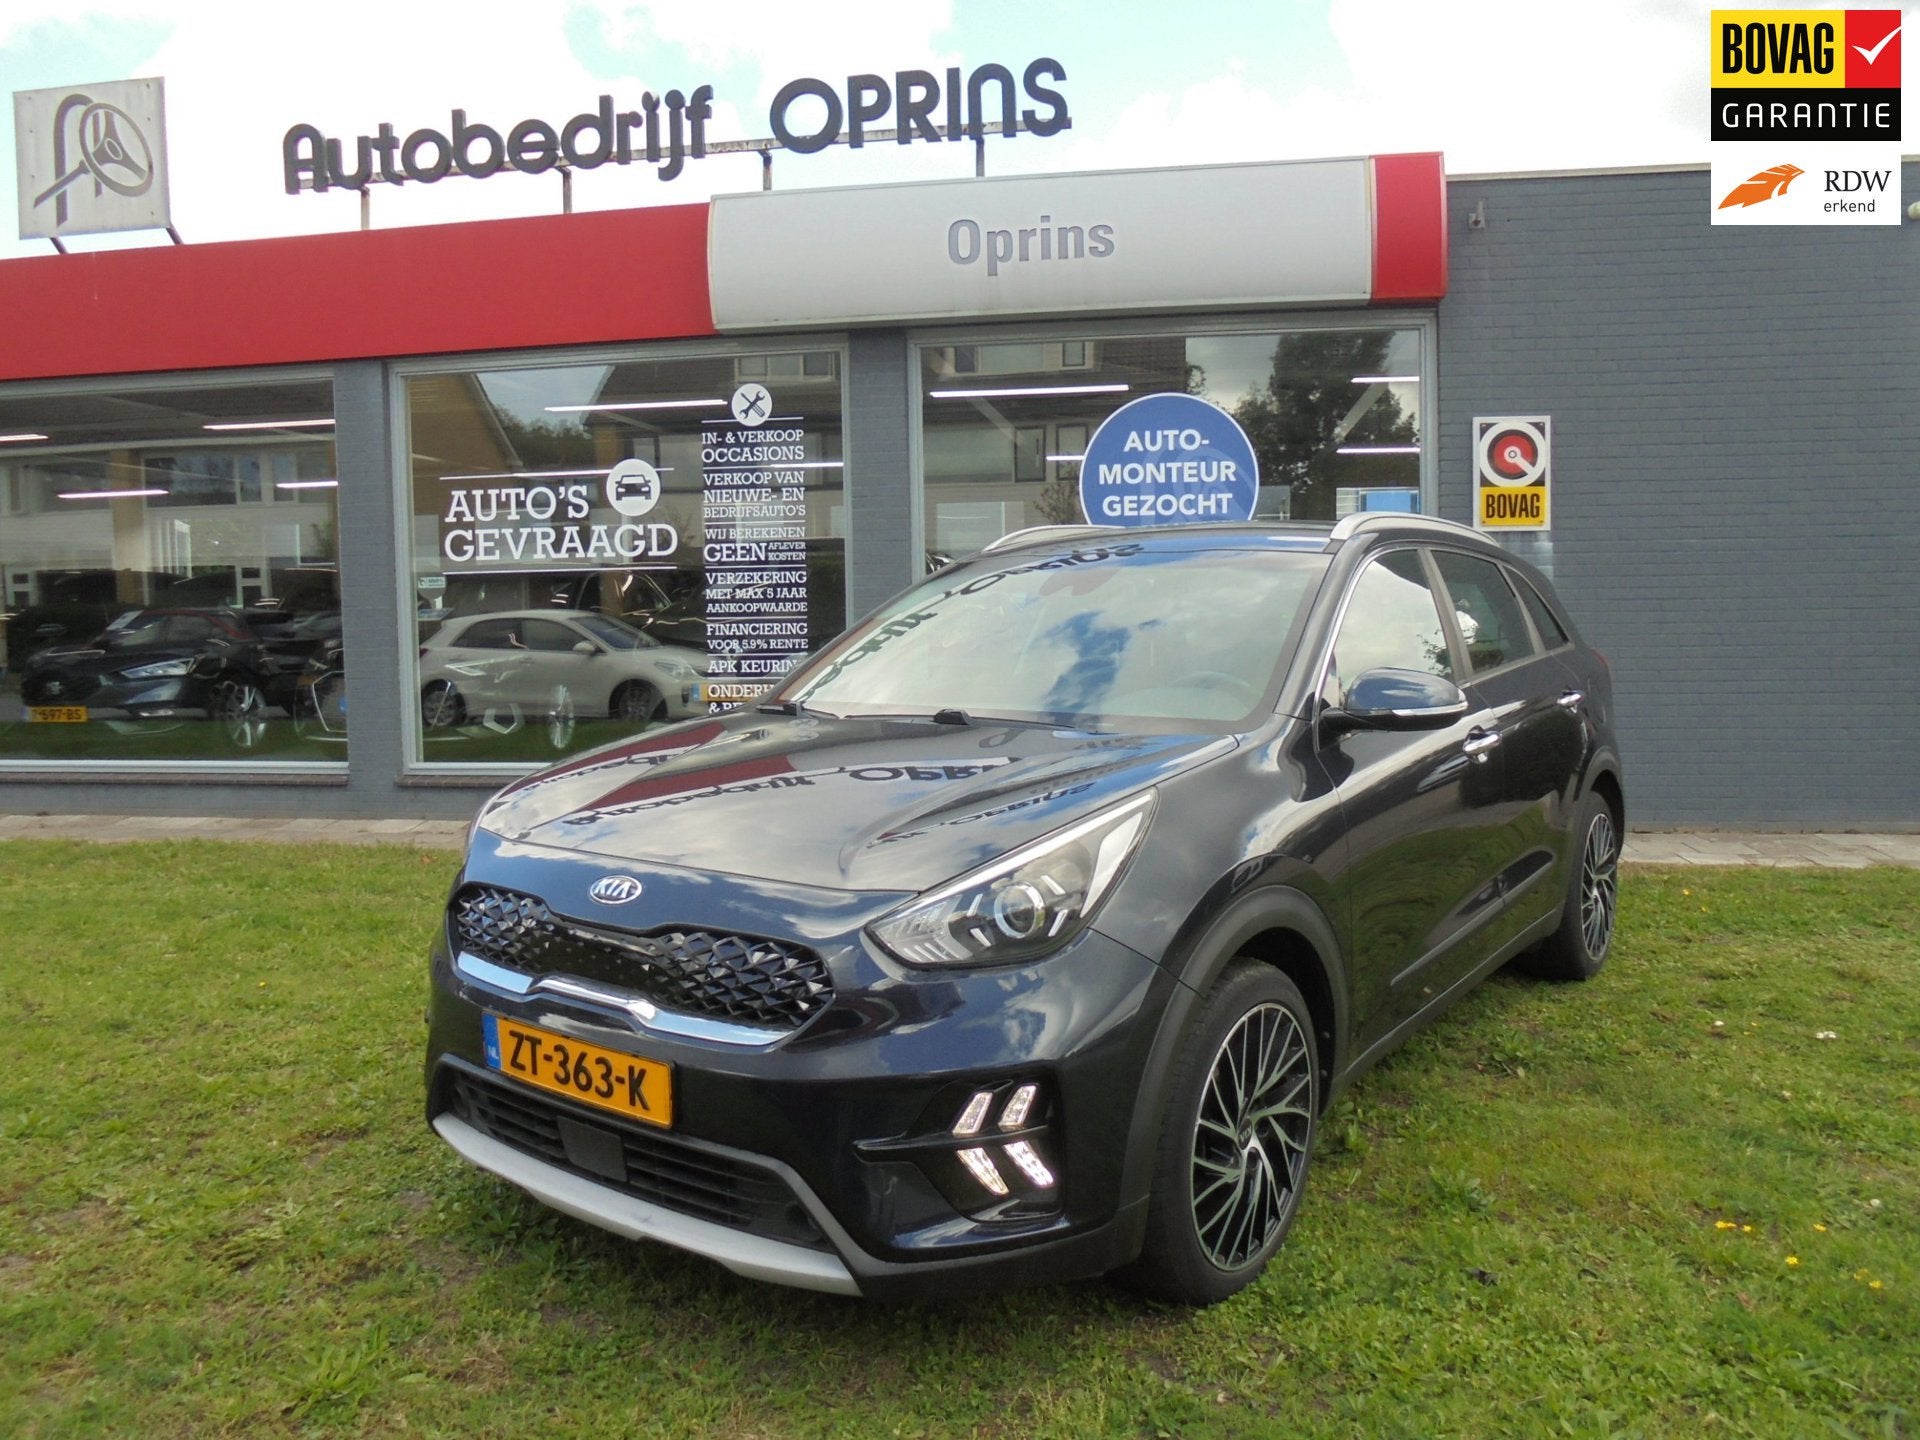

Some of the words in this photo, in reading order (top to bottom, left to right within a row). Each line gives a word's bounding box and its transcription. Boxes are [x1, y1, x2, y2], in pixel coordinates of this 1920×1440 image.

[283, 84, 713, 195] Autobedrijf
[769, 57, 1068, 154] OPRINS
[948, 214, 1116, 277] Oprins
[702, 432, 723, 444] IN-
[725, 431, 736, 444] &
[737, 430, 805, 443] VERKOOP
[1123, 429, 1210, 452] AUTO-
[701, 446, 805, 463] OCCASIONS
[703, 472, 772, 485] VERKOOP
[774, 471, 805, 483] VAN
[1099, 461, 1236, 485] MONTEUR
[703, 488, 778, 503] NIEUWE-
[781, 487, 806, 501] EN
[445, 485, 589, 523] AUTO'S
[703, 505, 806, 518] BEDRIJFSAUTO'S
[1102, 493, 1233, 517] GEZOCHT
[1485, 493, 1540, 518] BOVAG
[705, 528, 727, 540] WIJ
[729, 527, 806, 540] BEREKENEN
[444, 523, 678, 562] GEVRAAGD
[768, 542, 806, 550] AFLEVER
[703, 543, 767, 562] GEEN
[768, 552, 806, 561] KOSTEN
[705, 571, 807, 585] VERZEKERING
[705, 589, 733, 600] MET
[735, 588, 763, 599] MAX
[766, 588, 774, 598] 5
[776, 587, 807, 598] JAAR
[706, 602, 808, 613] AANKOOPWAARDE
[706, 623, 808, 636] FINANCIERING
[707, 640, 740, 650] VOOR
[742, 640, 768, 649] 5.9%
[769, 639, 808, 649] RENTE
[707, 660, 738, 673] APK
[594, 878, 631, 898] KIA
[509, 1029, 650, 1111] ZT-363-K
